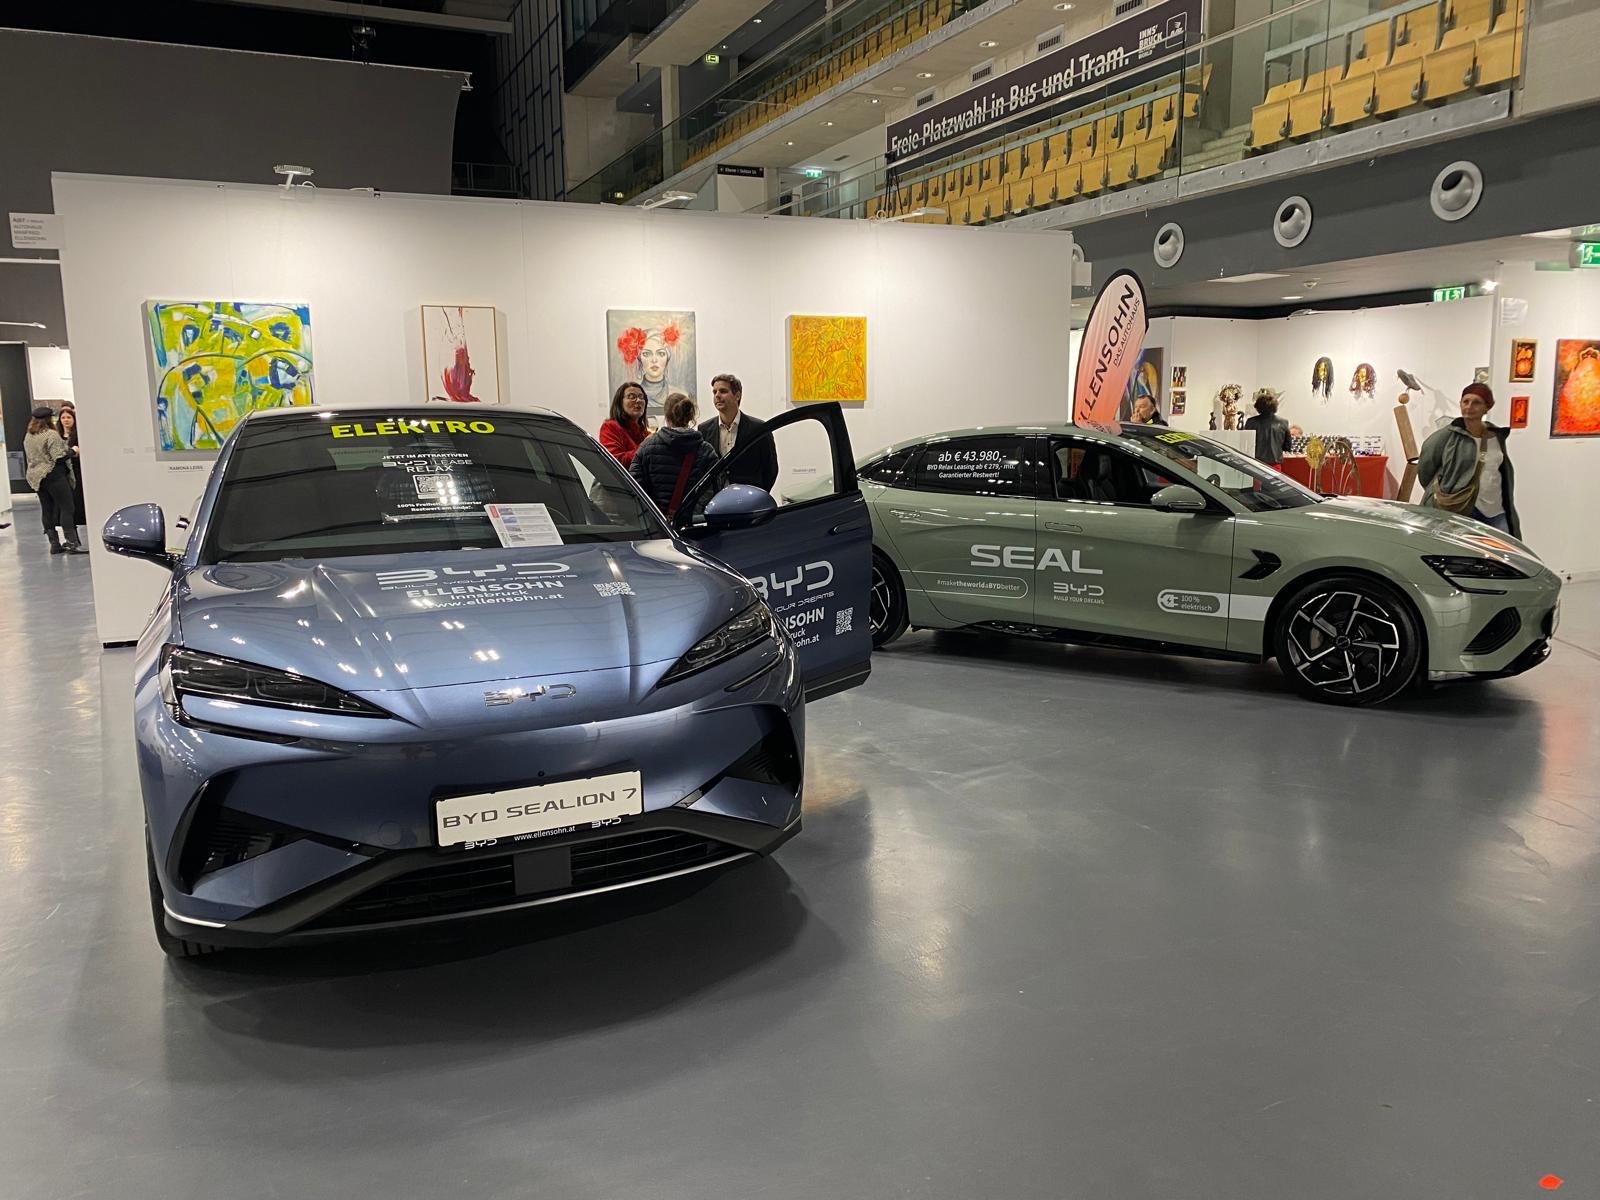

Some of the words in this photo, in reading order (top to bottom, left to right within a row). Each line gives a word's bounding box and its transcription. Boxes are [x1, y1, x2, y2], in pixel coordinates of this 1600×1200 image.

[891, 128, 919, 157] Freie
[922, 96, 987, 146] Platzwahl
[990, 93, 1005, 119] in
[1008, 82, 1038, 112] Bus
[1042, 58, 1076, 98] und
[1078, 46, 1130, 83] Tram.
[1120, 298, 1140, 346] AUTOHAUS
[1078, 283, 1135, 422] LLENSOHN
[331, 419, 496, 439] ELEKTRO
[938, 450, 952, 462] ab
[954, 451, 962, 462] €
[963, 450, 1007, 463] 43.980,-
[406, 465, 454, 473] RELAX
[938, 471, 972, 479] Garantierter
[970, 544, 1104, 575] SEAL
[375, 562, 570, 585] BYD
[407, 580, 565, 598] ELLENSOHN
[450, 590, 529, 600] Innsbruck
[1053, 582, 1105, 597] BYD
[420, 593, 565, 610] ww.ellensohn.at
[1180, 603, 1213, 611] elektrisch
[483, 683, 577, 707] BYD
[443, 809, 498, 828] BYD
[506, 791, 616, 819] SEALION
[622, 788, 637, 799] 7
[464, 838, 498, 850] BYD
[514, 825, 576, 842] www.ellensohn.at
[591, 817, 622, 829] BYD
